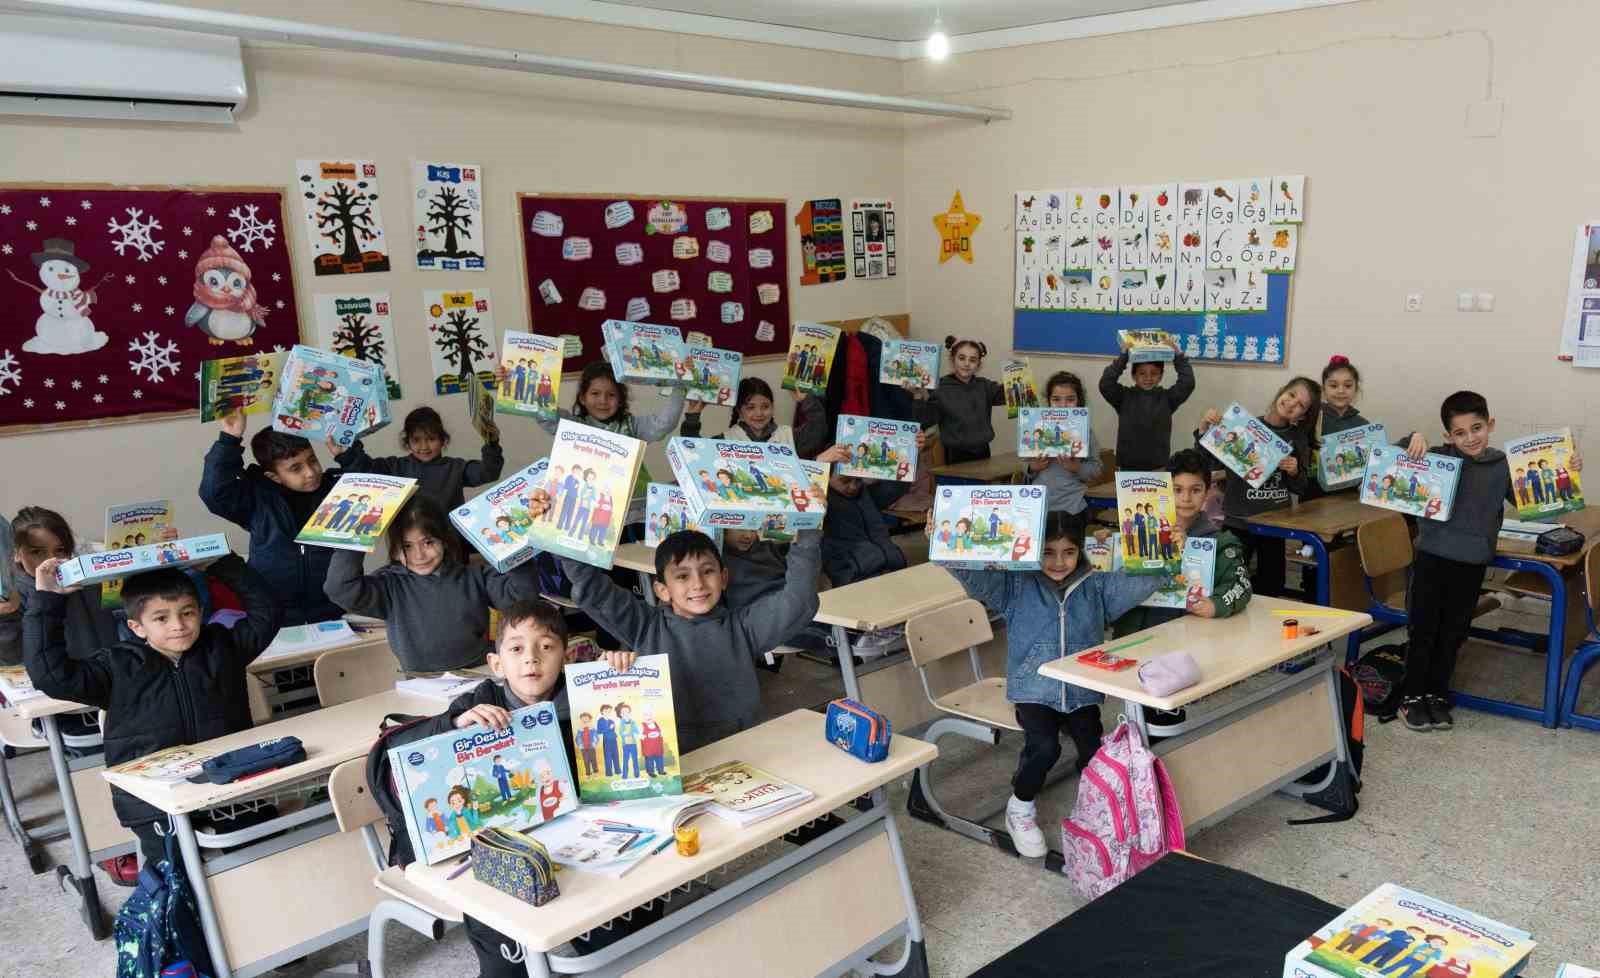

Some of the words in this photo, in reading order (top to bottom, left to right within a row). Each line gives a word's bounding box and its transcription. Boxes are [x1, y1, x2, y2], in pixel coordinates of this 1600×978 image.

[608, 666, 659, 678] Adaşları
[455, 739, 473, 752] Bir
[474, 728, 513, 745] Destek
[456, 750, 475, 763] Bin
[476, 737, 515, 758] Bereket
